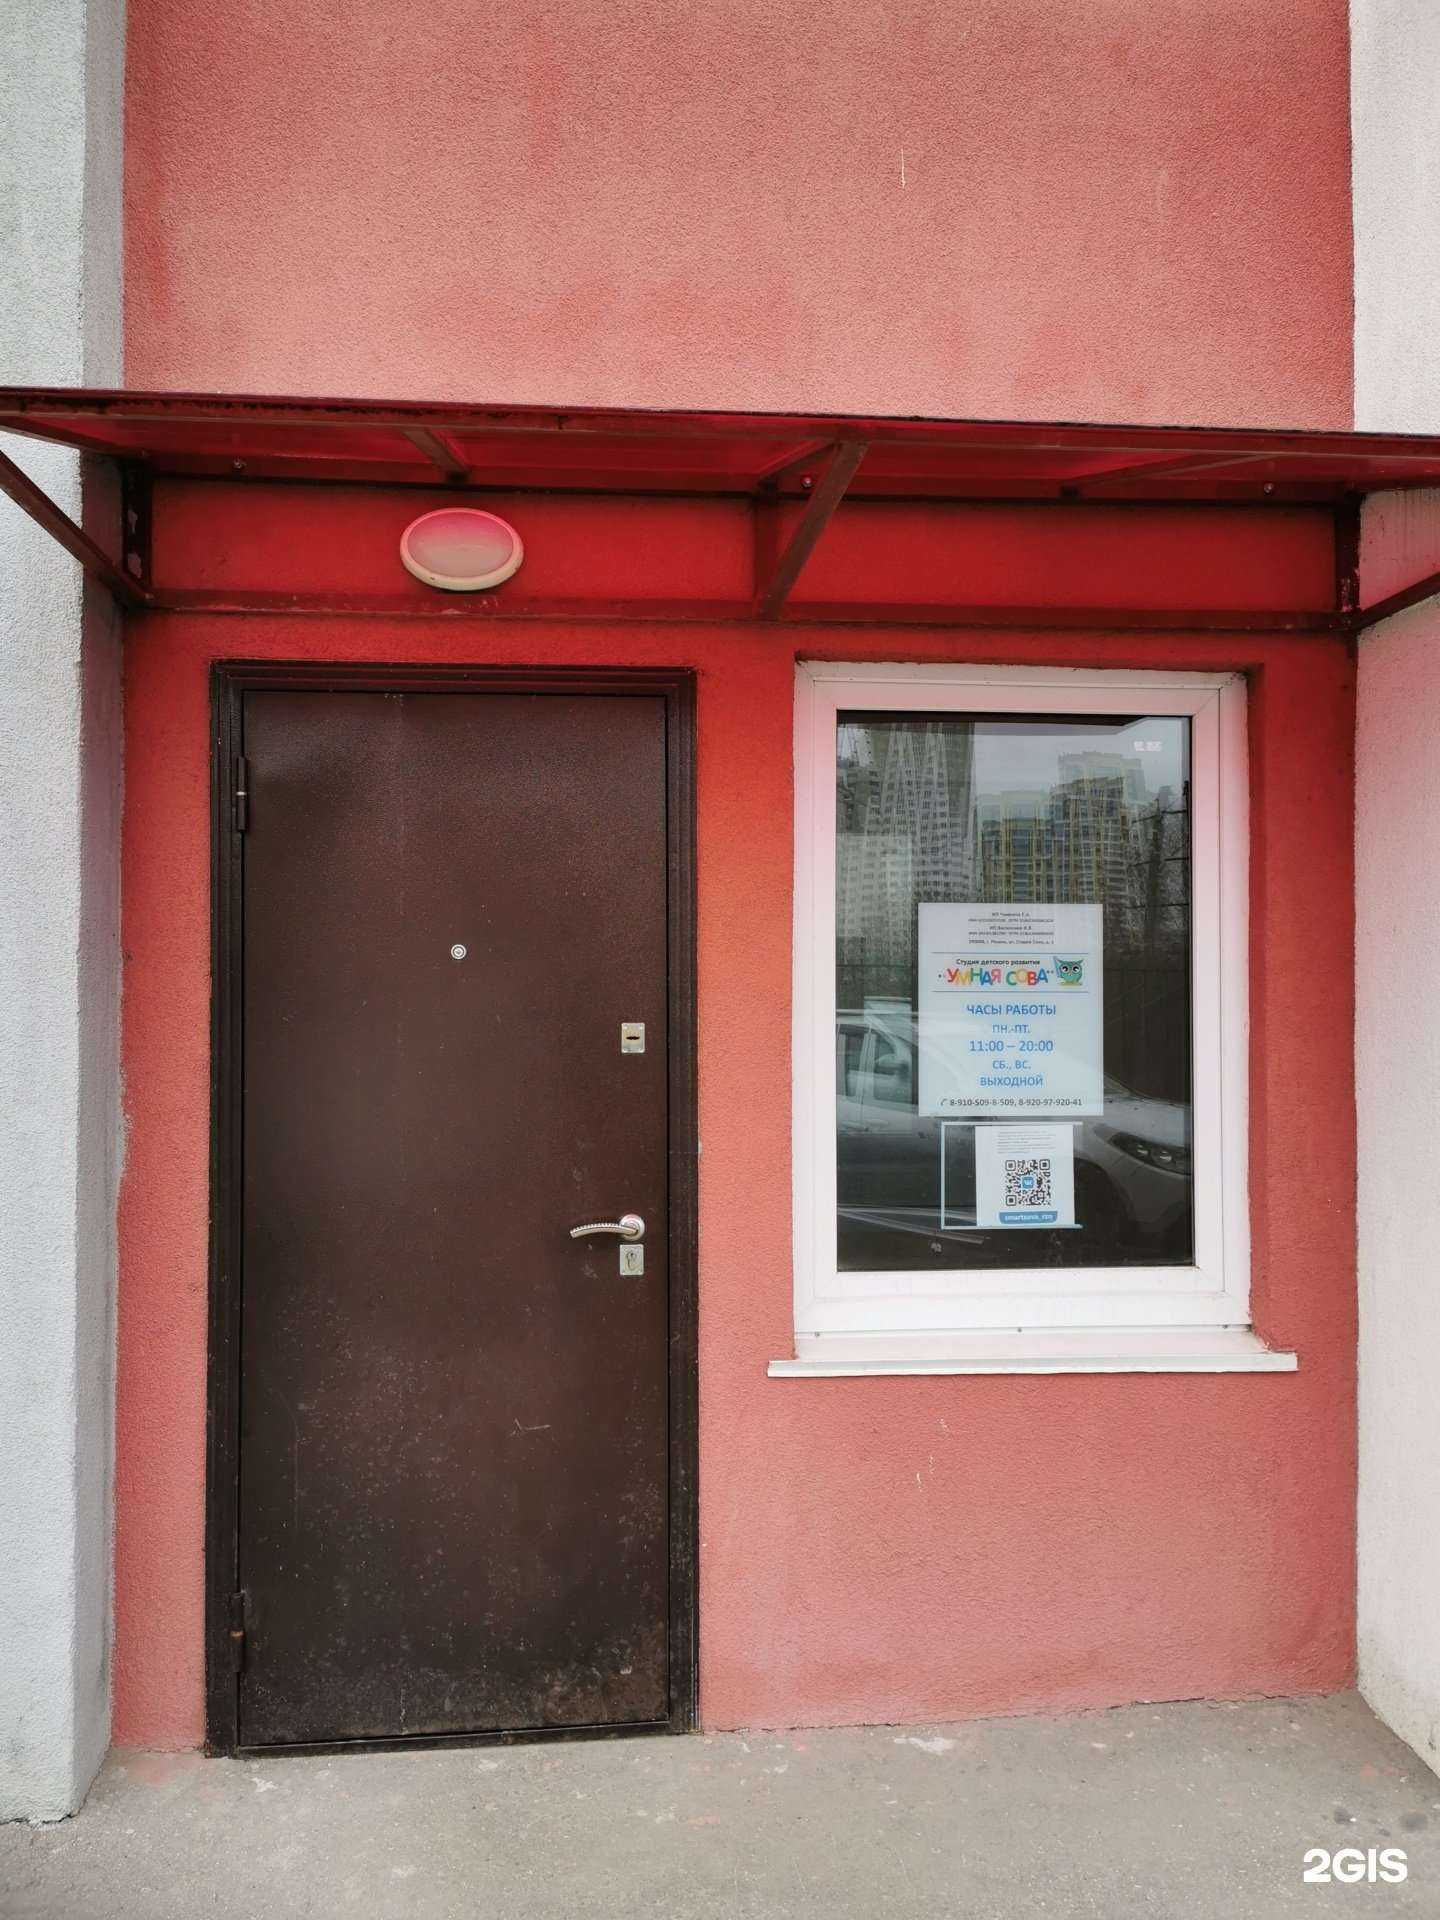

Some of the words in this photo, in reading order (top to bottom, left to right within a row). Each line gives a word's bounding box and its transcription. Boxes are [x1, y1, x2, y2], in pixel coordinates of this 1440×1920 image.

[955, 958, 979, 966] Студия
[947, 967, 1002, 986] УМНАЯ
[1005, 968, 1048, 986] СОВА
[966, 1004, 1002, 1015] ЧАСЫ
[1005, 1004, 1056, 1015] РАБОТЫ
[969, 1040, 1004, 1052] 11:00
[1018, 1040, 1054, 1052] 20:00
[1015, 1060, 1031, 1070] ВС.
[979, 1074, 1044, 1087] ВЫХОДНОЙ
